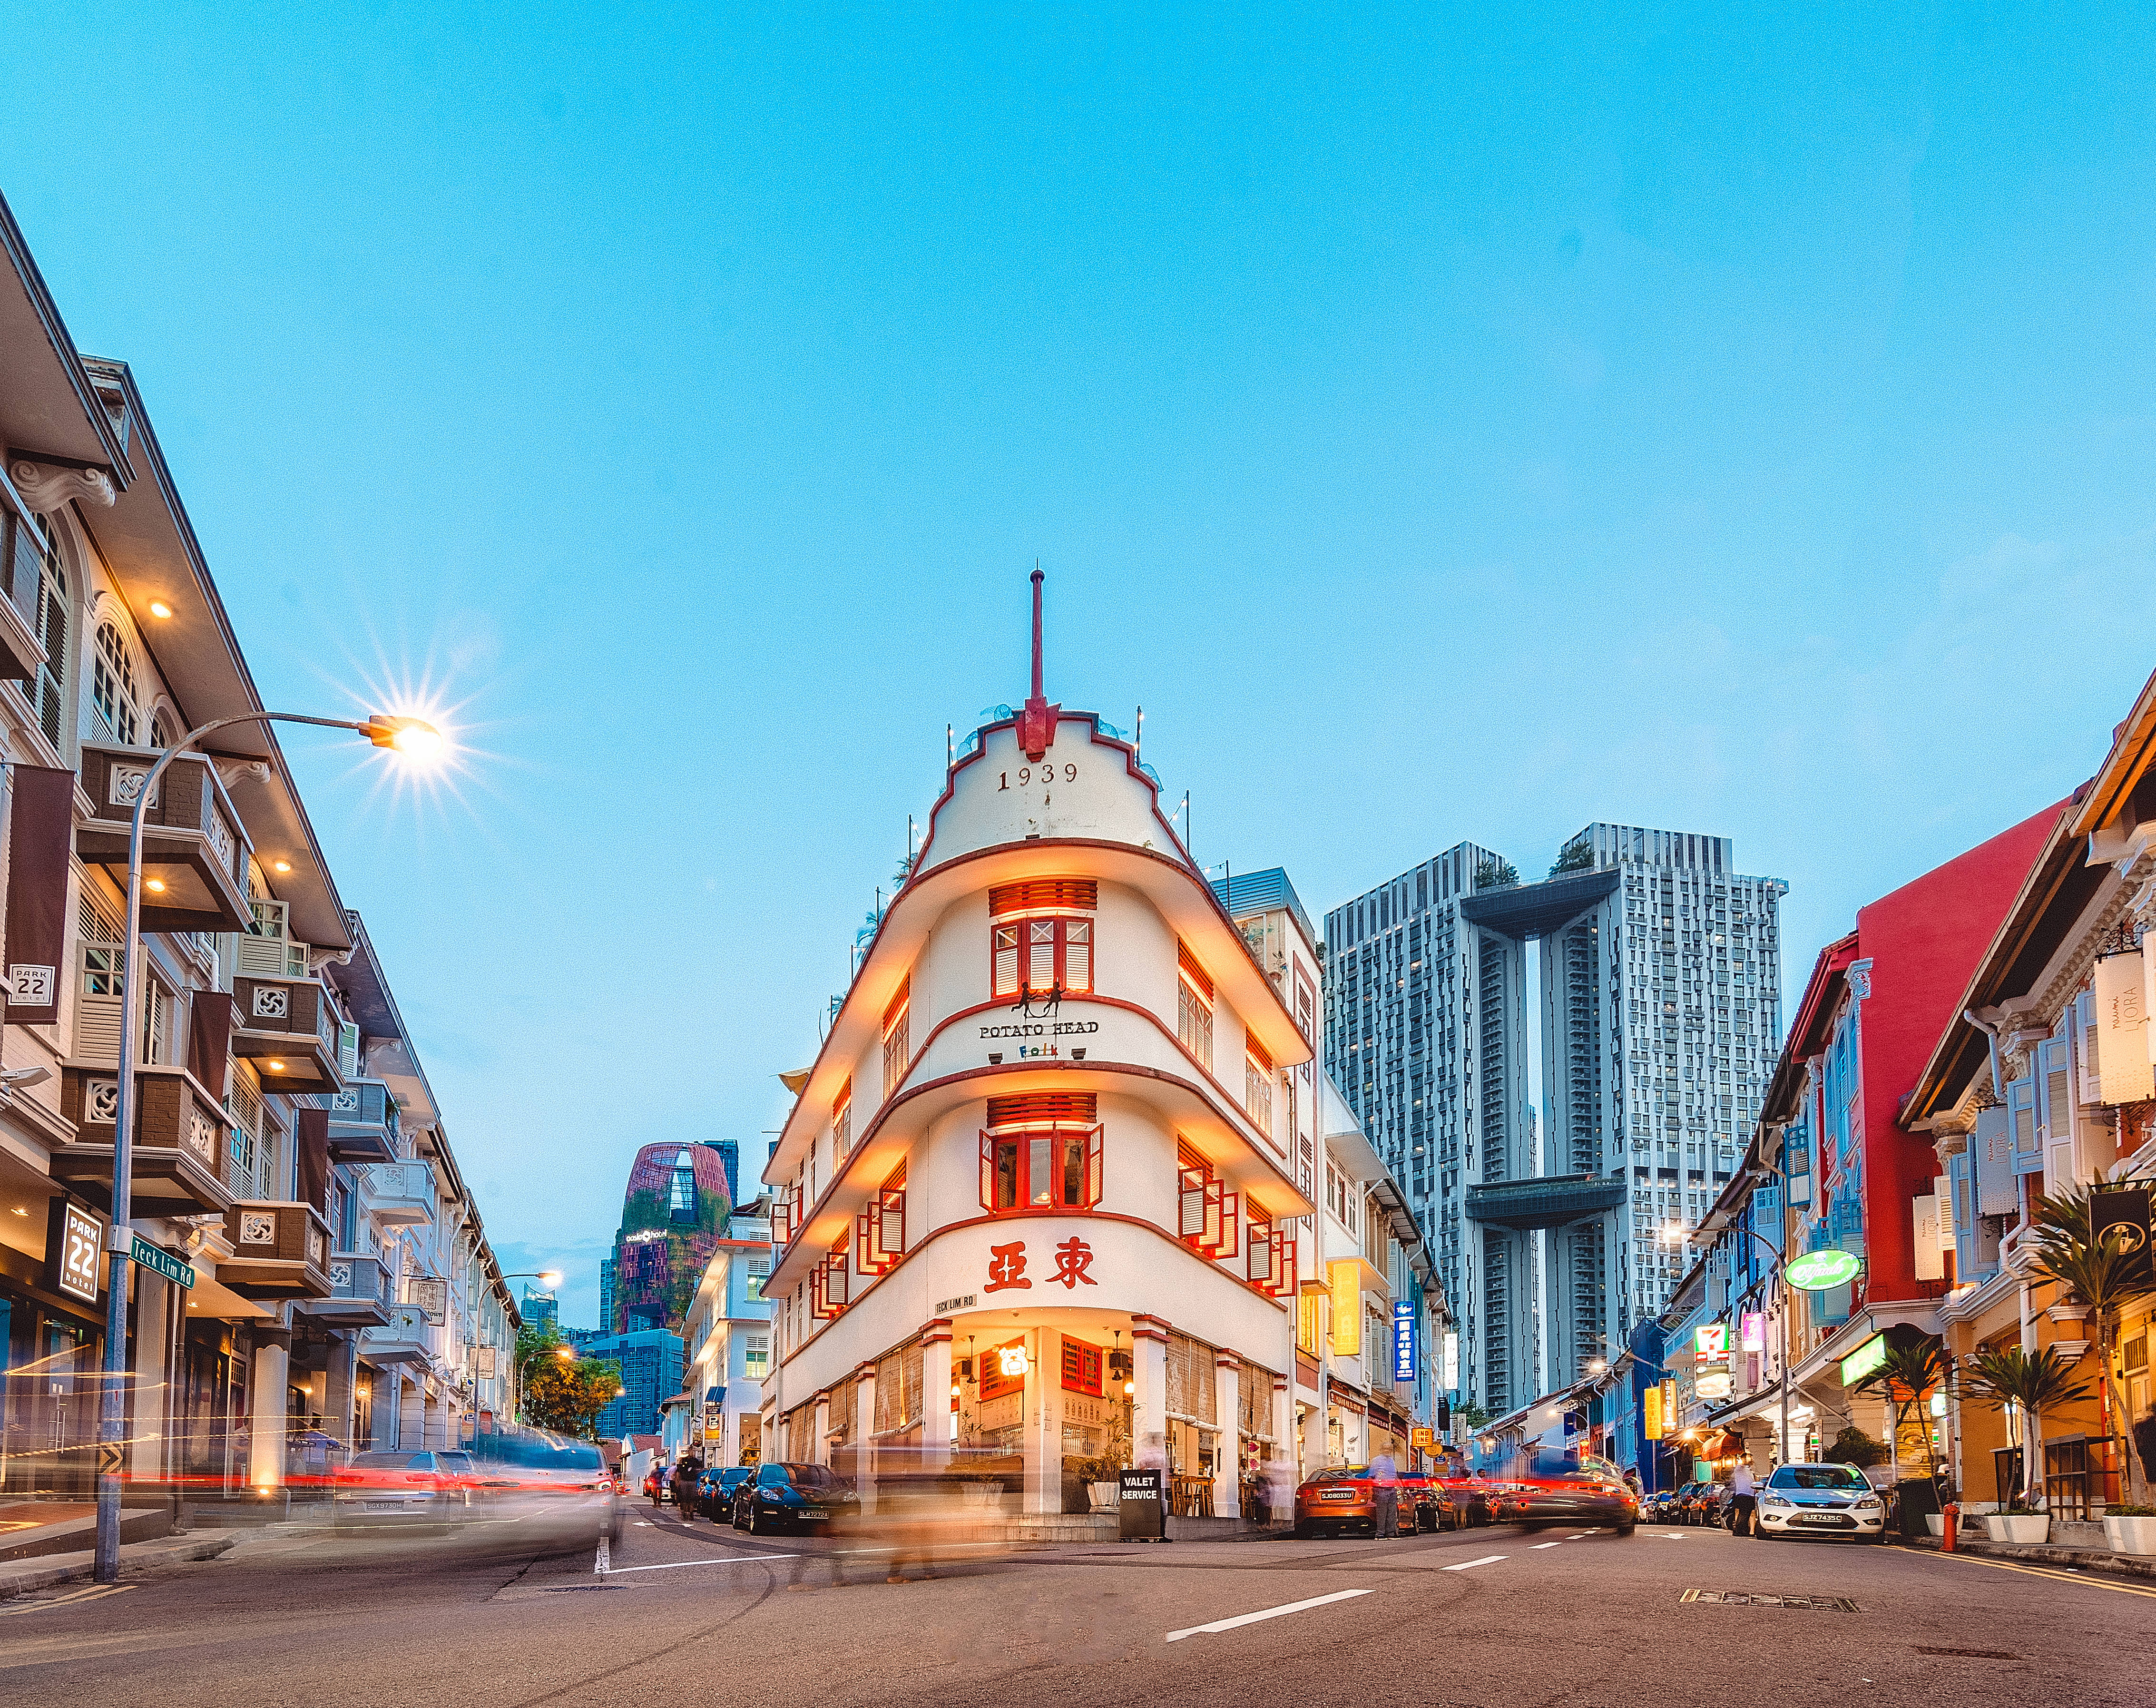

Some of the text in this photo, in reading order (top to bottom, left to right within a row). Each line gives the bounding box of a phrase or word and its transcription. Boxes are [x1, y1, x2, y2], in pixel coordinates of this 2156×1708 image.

[998, 763, 1077, 792] 1939
[18, 978, 44, 994] 22
[2124, 987, 2138, 1032] LIORA
[980, 1021, 1099, 1039] POTATO HEAD
[1019, 1042, 1058, 1059] Folk
[1995, 1130, 2007, 1164] LIORA
[69, 1216, 98, 1243] PARK
[68, 1235, 95, 1279] 22
[134, 1240, 192, 1286] Teck Lim Rd
[66, 1271, 93, 1292] hotel
[936, 1296, 973, 1312] TECK LIM RD
[1124, 1477, 1155, 1487] VALET
[1122, 1490, 1157, 1500] SERVICE
